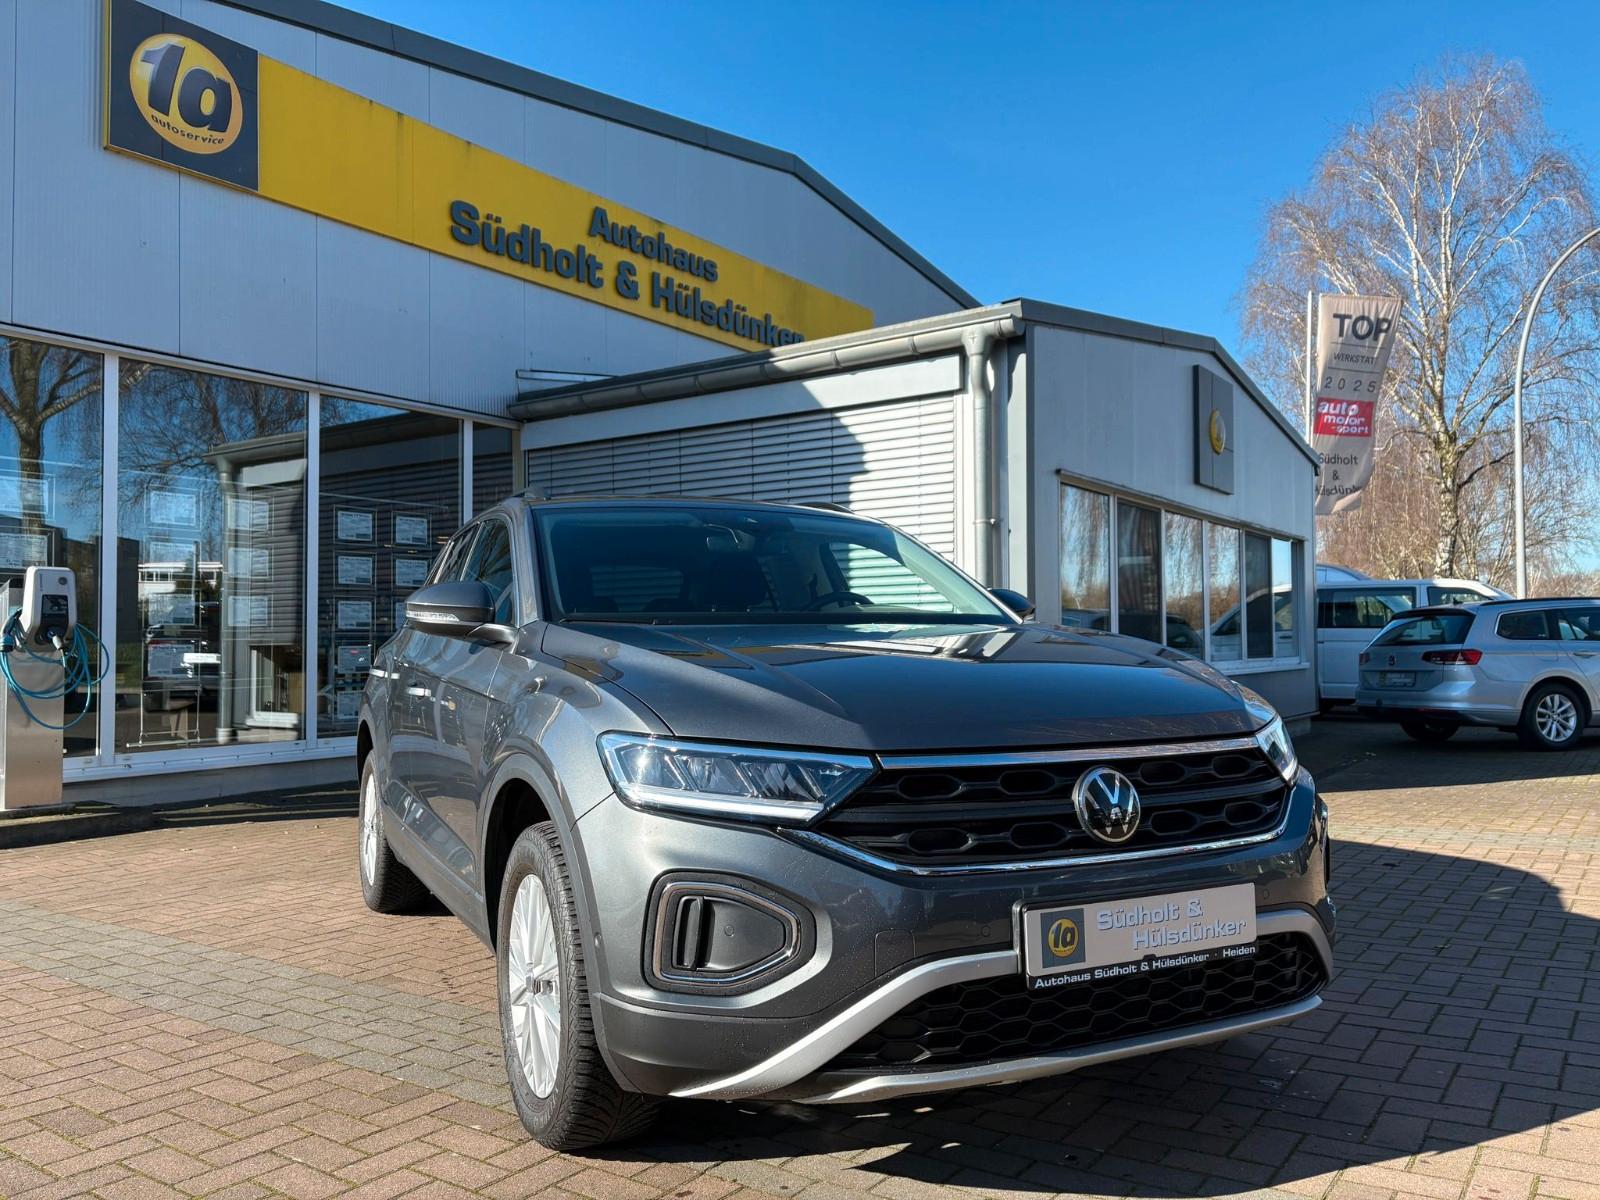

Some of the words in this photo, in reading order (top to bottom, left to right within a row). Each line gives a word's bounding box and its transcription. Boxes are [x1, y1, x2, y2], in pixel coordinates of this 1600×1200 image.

[140, 43, 232, 133] 1a
[150, 113, 225, 145] autoservice
[450, 200, 604, 288] Südholt
[615, 260, 640, 301] &
[588, 206, 719, 282] Autohaus
[1332, 312, 1392, 341] TOP
[1324, 376, 1377, 393] 2025
[1332, 469, 1341, 481] &
[1096, 901, 1181, 931] Südholt
[1186, 899, 1204, 918] &
[1133, 918, 1248, 950] Hülsdünker
[1035, 973, 1091, 989] Autohaus
[1094, 965, 1137, 979] Südholt
[1140, 962, 1150, 971] &
[1152, 952, 1210, 970] Hülsdünker
[1222, 945, 1256, 959] Heiden
